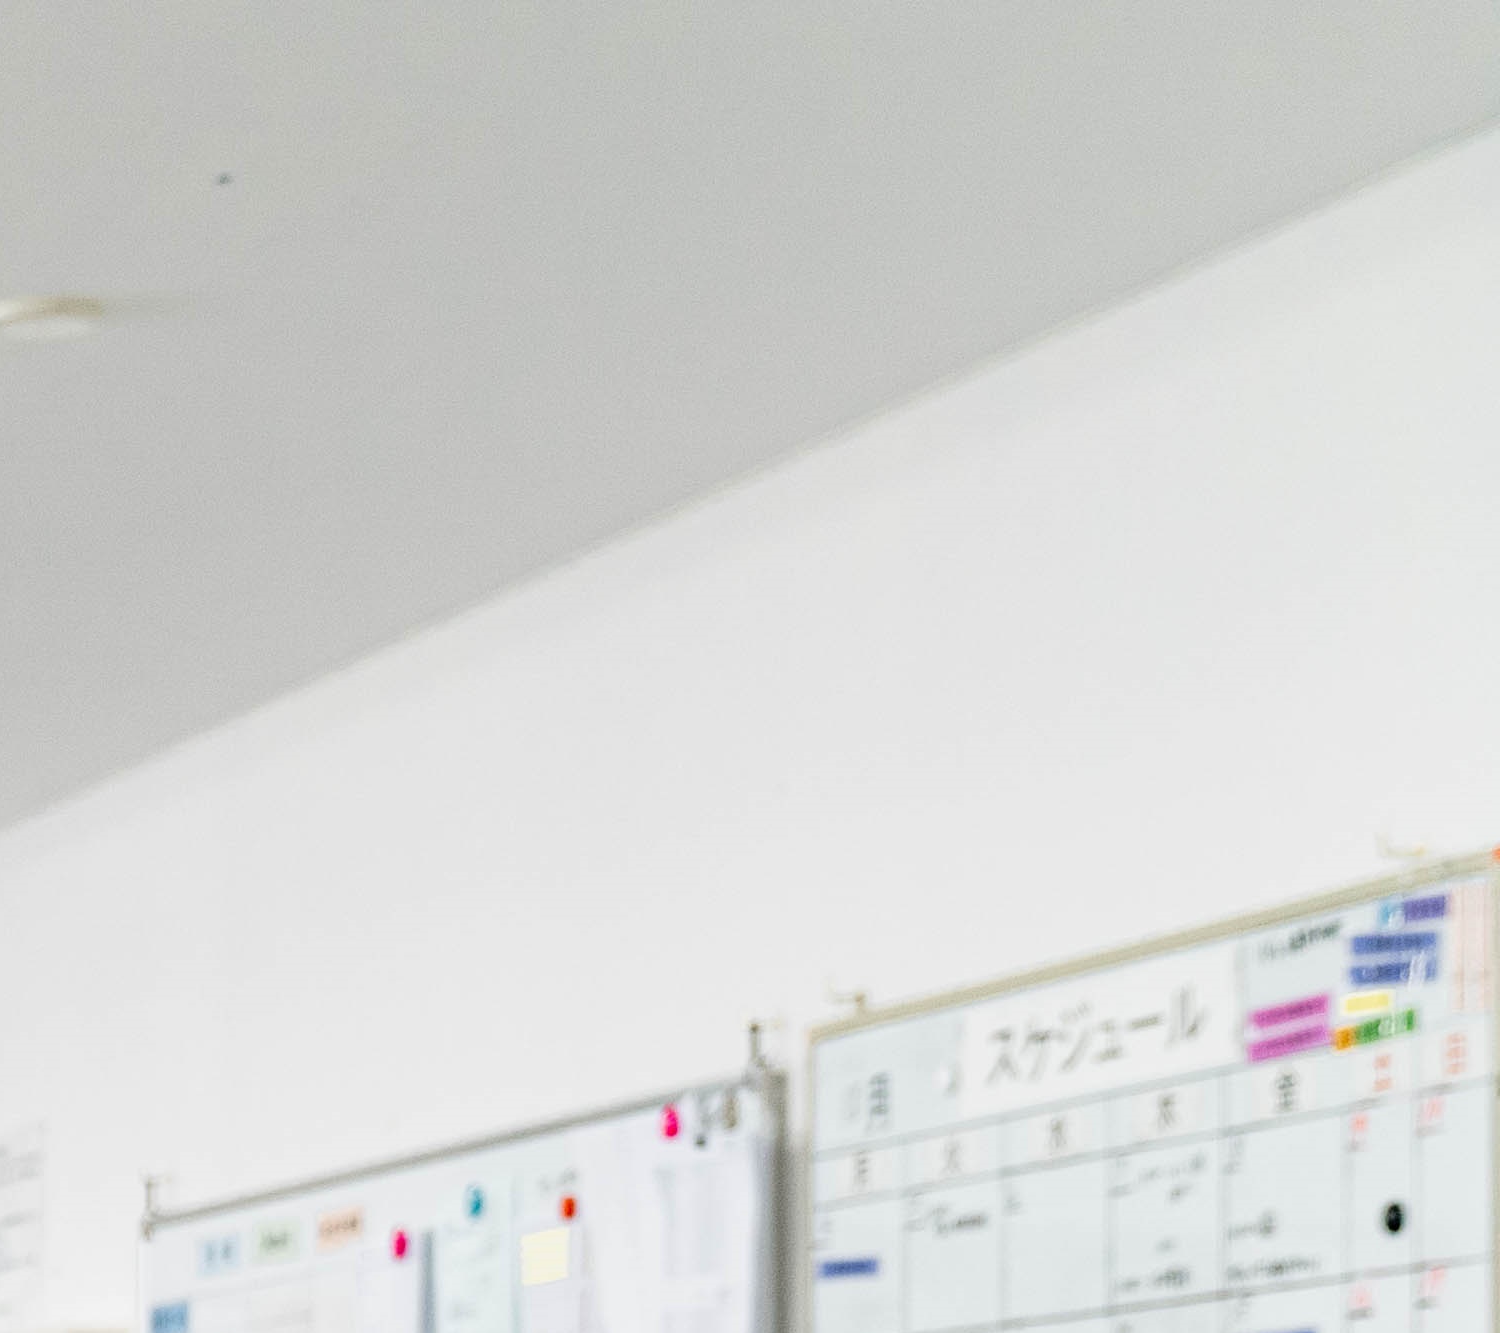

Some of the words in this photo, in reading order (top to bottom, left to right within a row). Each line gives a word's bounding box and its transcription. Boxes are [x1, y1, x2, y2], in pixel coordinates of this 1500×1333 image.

[985, 980, 1213, 1086] スケジュール
